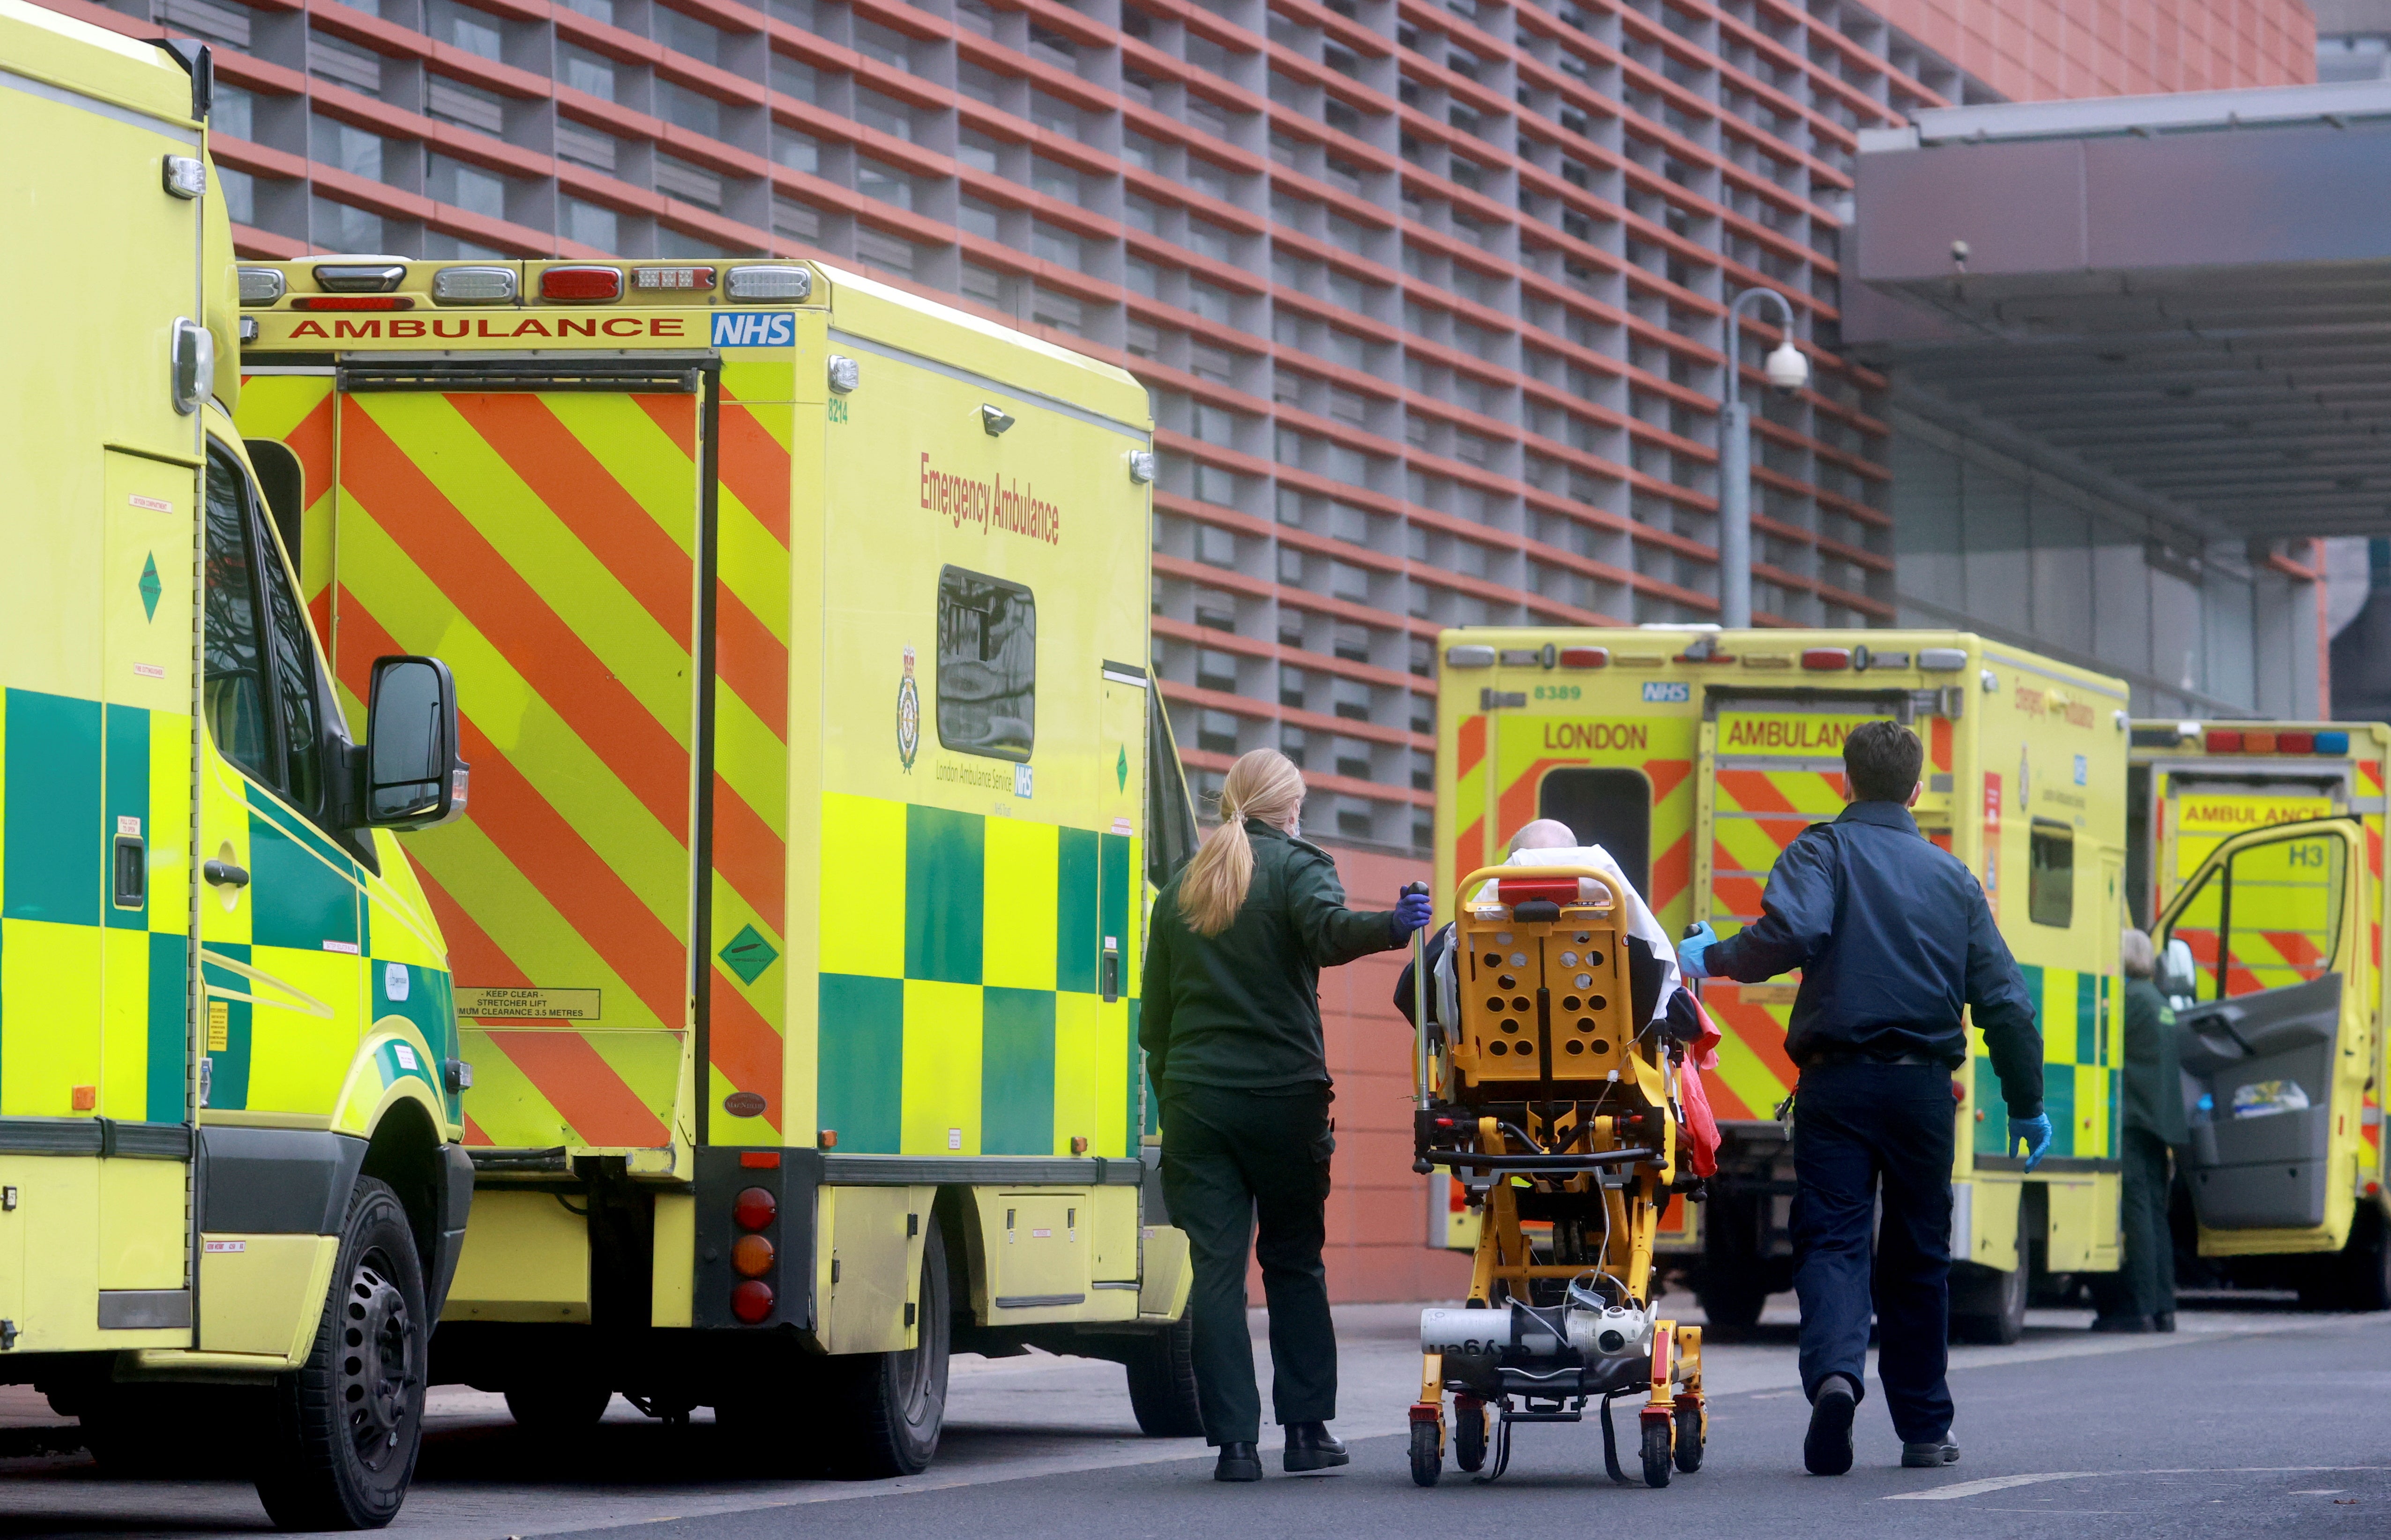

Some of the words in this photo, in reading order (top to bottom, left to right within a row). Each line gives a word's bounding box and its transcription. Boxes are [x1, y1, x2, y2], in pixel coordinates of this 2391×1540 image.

[289, 318, 684, 338] AMBULANCE
[713, 314, 792, 344] NHS
[828, 397, 847, 425] 8214
[921, 452, 990, 535] Emergency
[993, 472, 1058, 546] Ambulance
[1534, 686, 1581, 700] 8389
[1644, 683, 1686, 700] NHS
[1545, 723, 1647, 749] LONDON
[1728, 720, 1864, 748] AMBULAN
[936, 759, 957, 783] London
[959, 763, 991, 788] Ambulance
[993, 769, 1011, 792] Service
[1015, 766, 1032, 796] NHS
[2289, 844, 2323, 867] H3
